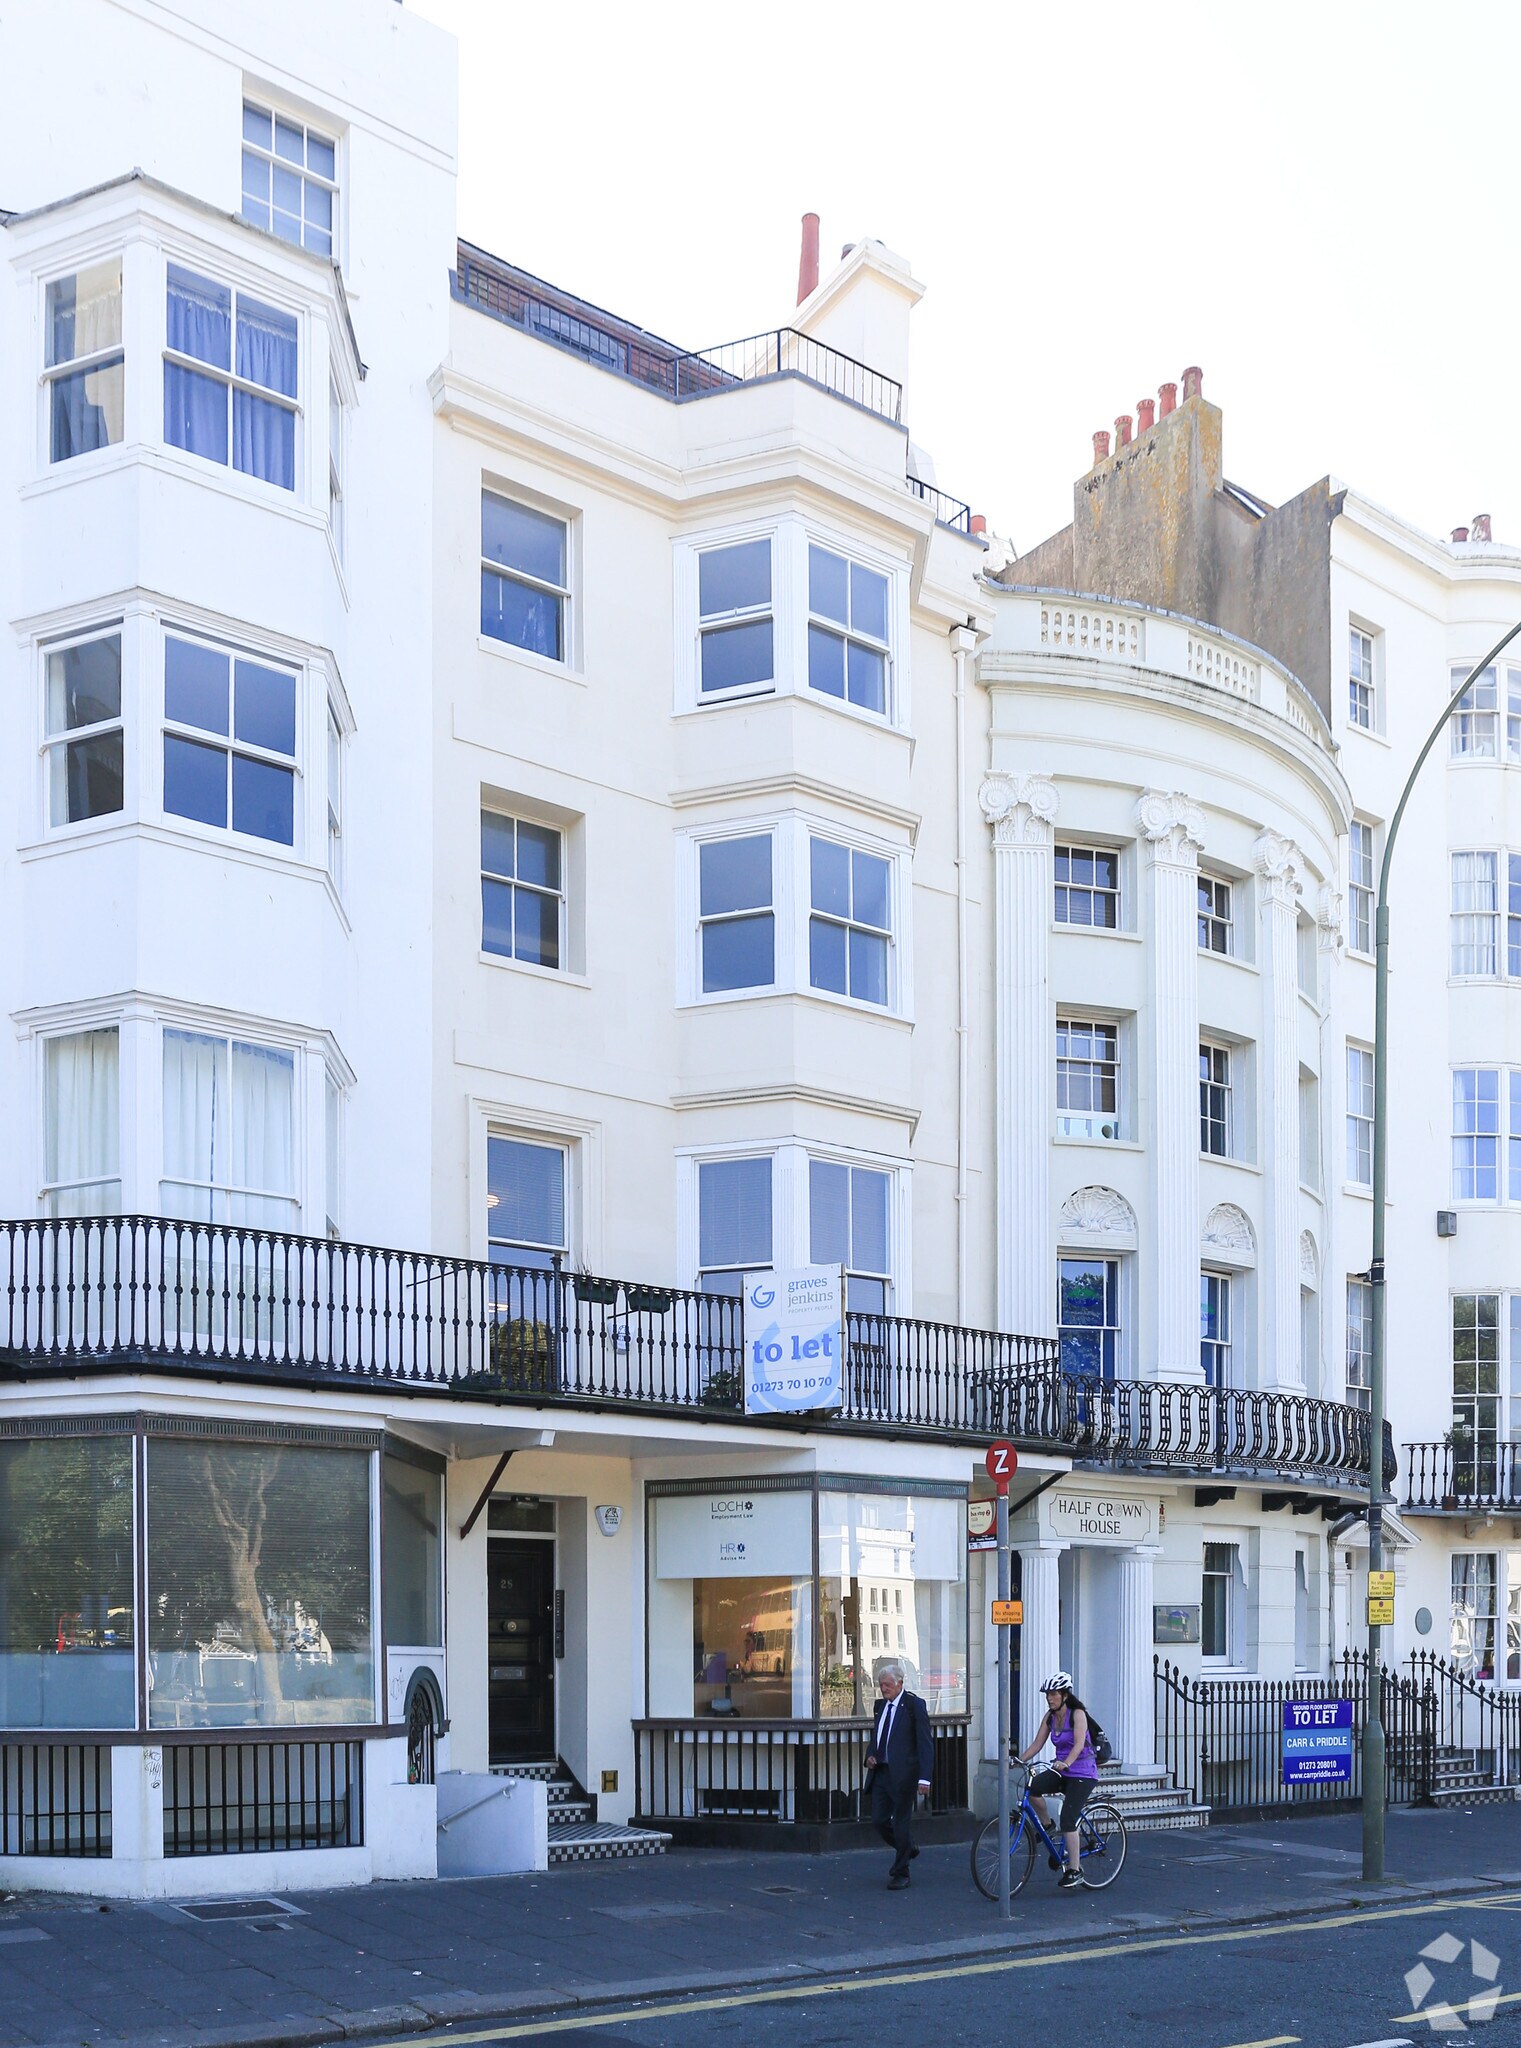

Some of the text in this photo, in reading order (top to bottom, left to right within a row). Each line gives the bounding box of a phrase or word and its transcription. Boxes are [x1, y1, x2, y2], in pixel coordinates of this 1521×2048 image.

[788, 1278, 827, 1292] graves
[788, 1291, 833, 1307] jenkins
[753, 1333, 833, 1363] to let
[752, 1377, 832, 1393] 01273 70 10 70
[994, 1449, 1009, 1474] Z
[1059, 1500, 1092, 1515] HALF
[1080, 1519, 1121, 1534] HOUSE
[720, 1543, 736, 1553] HR
[1293, 1710, 1337, 1725] TO LET
[1286, 1736, 1347, 1748] CARR & PRIDDLE
[1298, 1761, 1316, 1770] 01273
[1290, 1769, 1345, 1780] www.carrpriddle.co.uk
